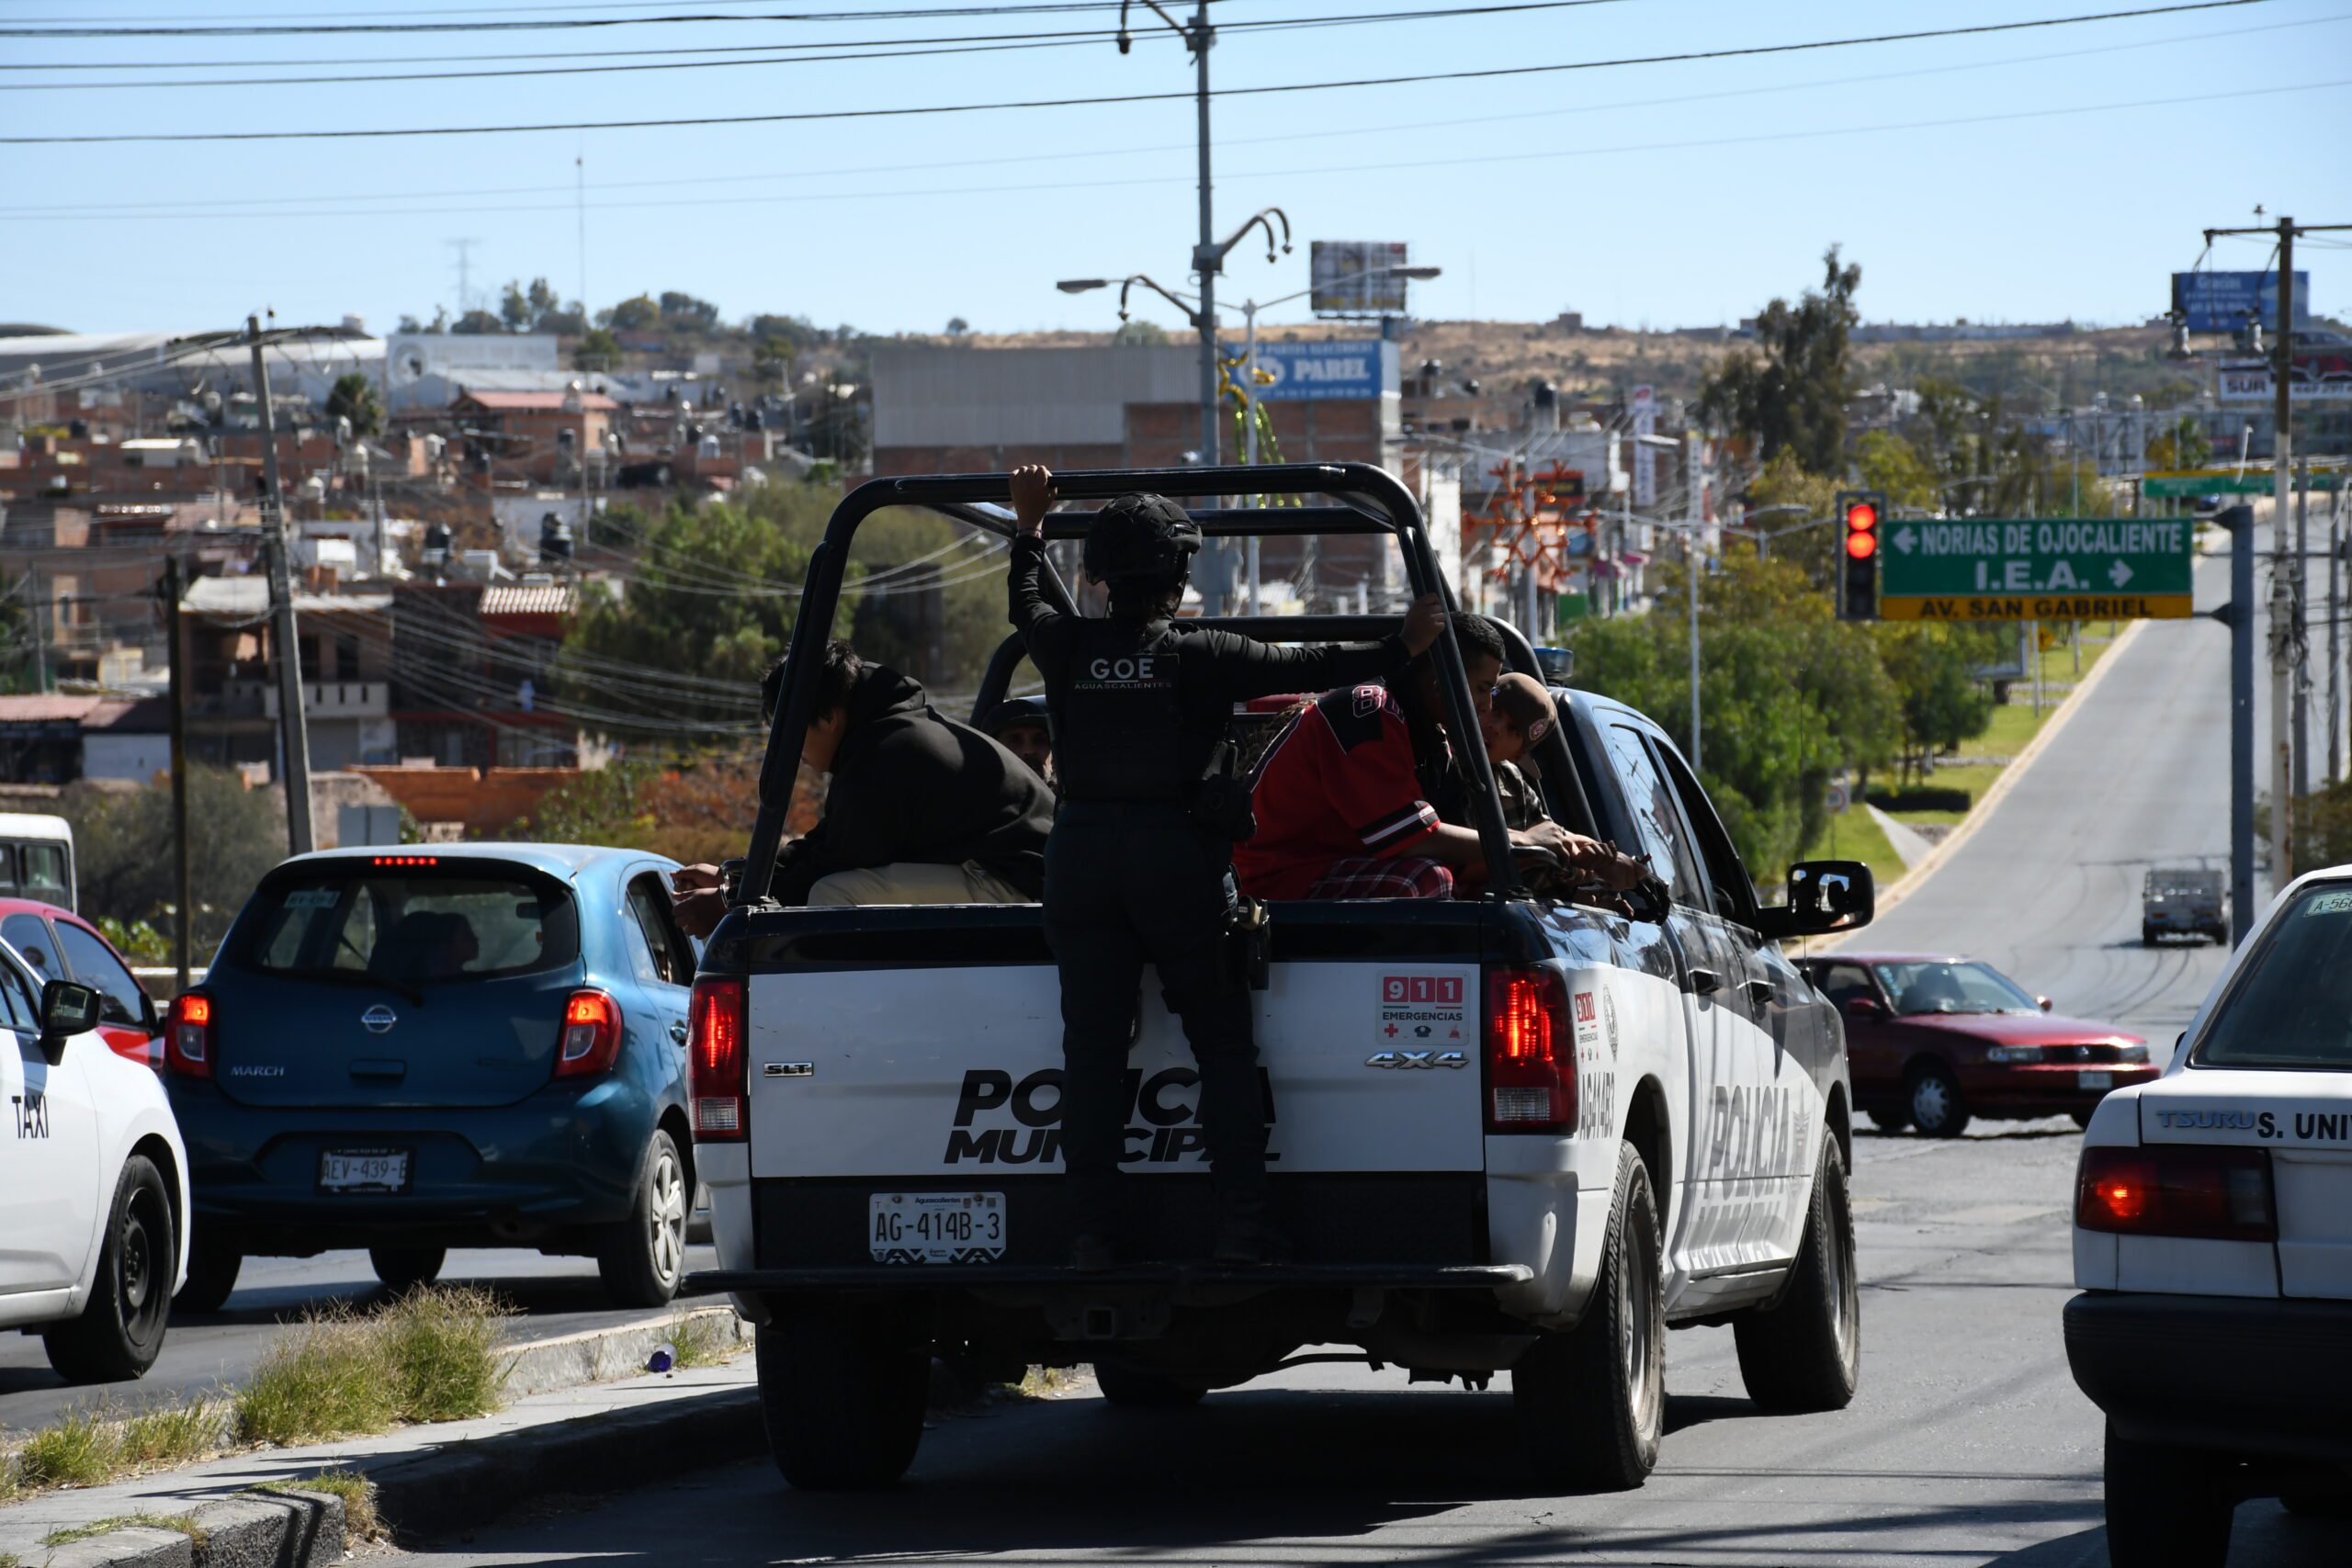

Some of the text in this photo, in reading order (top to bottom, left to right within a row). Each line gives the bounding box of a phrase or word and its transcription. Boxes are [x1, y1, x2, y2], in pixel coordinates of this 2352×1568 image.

[1294, 357, 1371, 382] PAREL
[1922, 523, 2183, 553] NORIAS DE OJOCALIENTE
[1975, 560, 2090, 591] I.E.A.
[1919, 599, 2154, 617] AV. SAN GABRIEL
[1090, 658, 1155, 680] GOE
[1074, 682, 1172, 690] AGUASCALIENTES
[1386, 979, 1457, 1001] 911
[1382, 1012, 1463, 1021] EMERGENCIAS
[1577, 994, 1595, 1020] 911
[231, 1066, 285, 1077] MARCH
[765, 1064, 809, 1075] SLT
[1364, 1051, 1469, 1069] 4X4
[953, 1066, 1277, 1128] POIC
[1579, 1071, 1615, 1141] AG414B3
[11, 1095, 50, 1139] TAXI
[2155, 1110, 2256, 1130] TSURU
[2256, 1111, 2352, 1141] S. UNI
[943, 1128, 1282, 1165] MUCIP
[1702, 1085, 1790, 1201] POLICIA
[875, 1212, 1001, 1242] AG-414B-3
